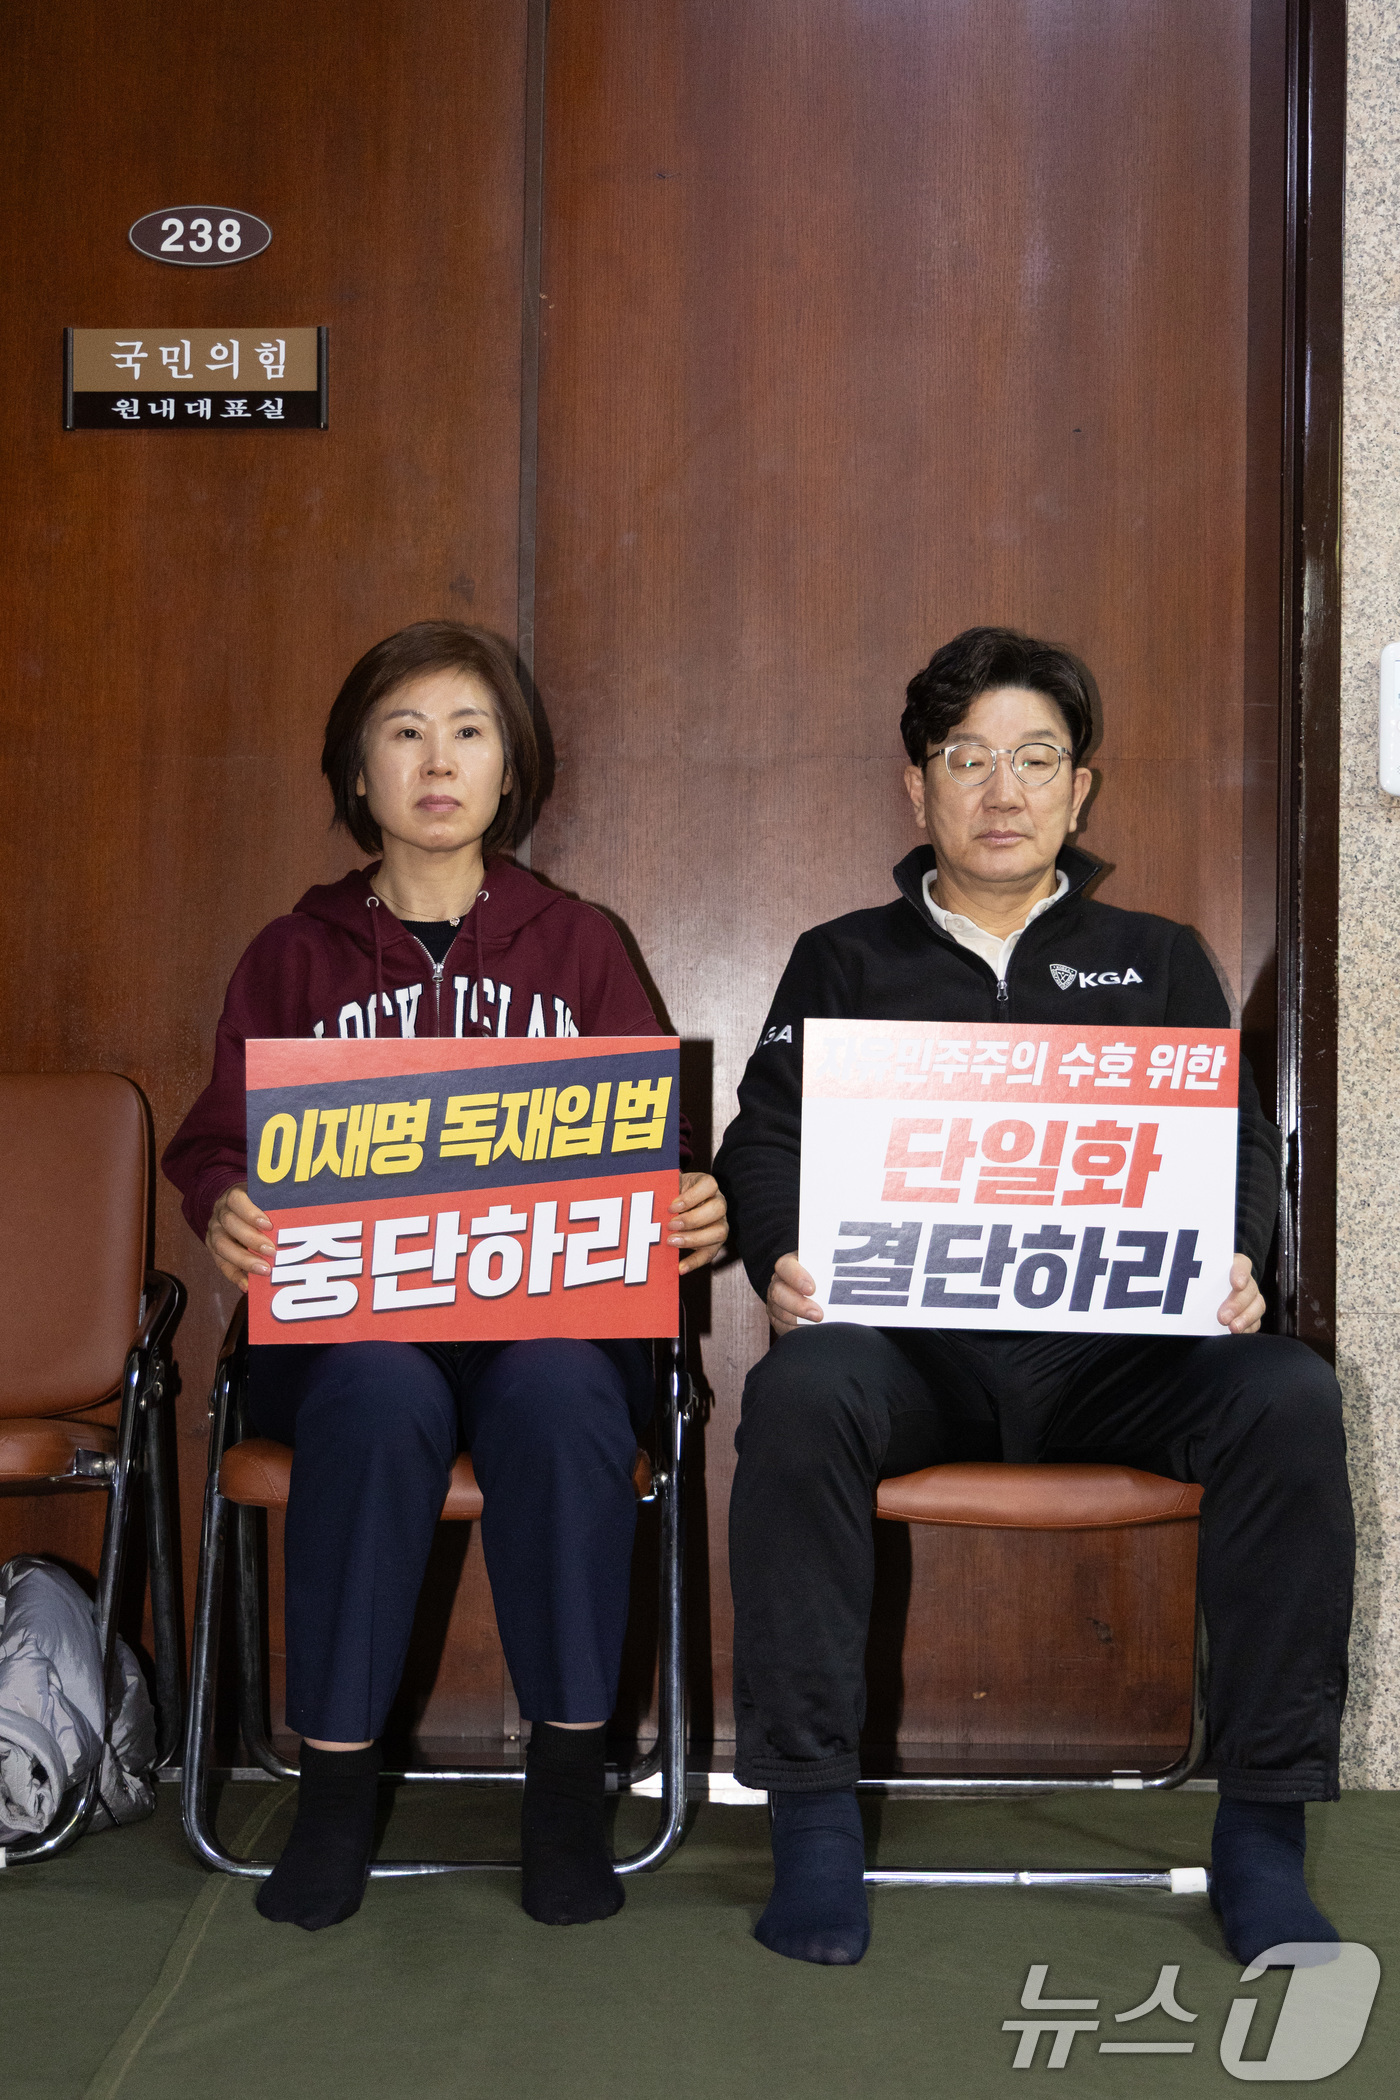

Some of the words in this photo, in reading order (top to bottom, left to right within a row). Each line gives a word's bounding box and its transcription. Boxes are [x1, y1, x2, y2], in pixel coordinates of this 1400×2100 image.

[160, 218, 242, 253] 238
[110, 339, 286, 381] 국민의힘
[111, 398, 285, 420] 원내대표실
[1078, 968, 1143, 988] KGA
[757, 1025, 792, 1049] GA
[815, 1036, 1049, 1086] 자유민주주의
[1058, 1042, 1137, 1088] 수호
[1146, 1044, 1227, 1091] 위한
[256, 1098, 431, 1184] 이재명
[439, 1076, 673, 1167] 독재입법
[881, 1117, 1163, 1209] 단일화
[271, 1190, 662, 1321] 중단하라
[828, 1221, 1203, 1315] 결단하라
